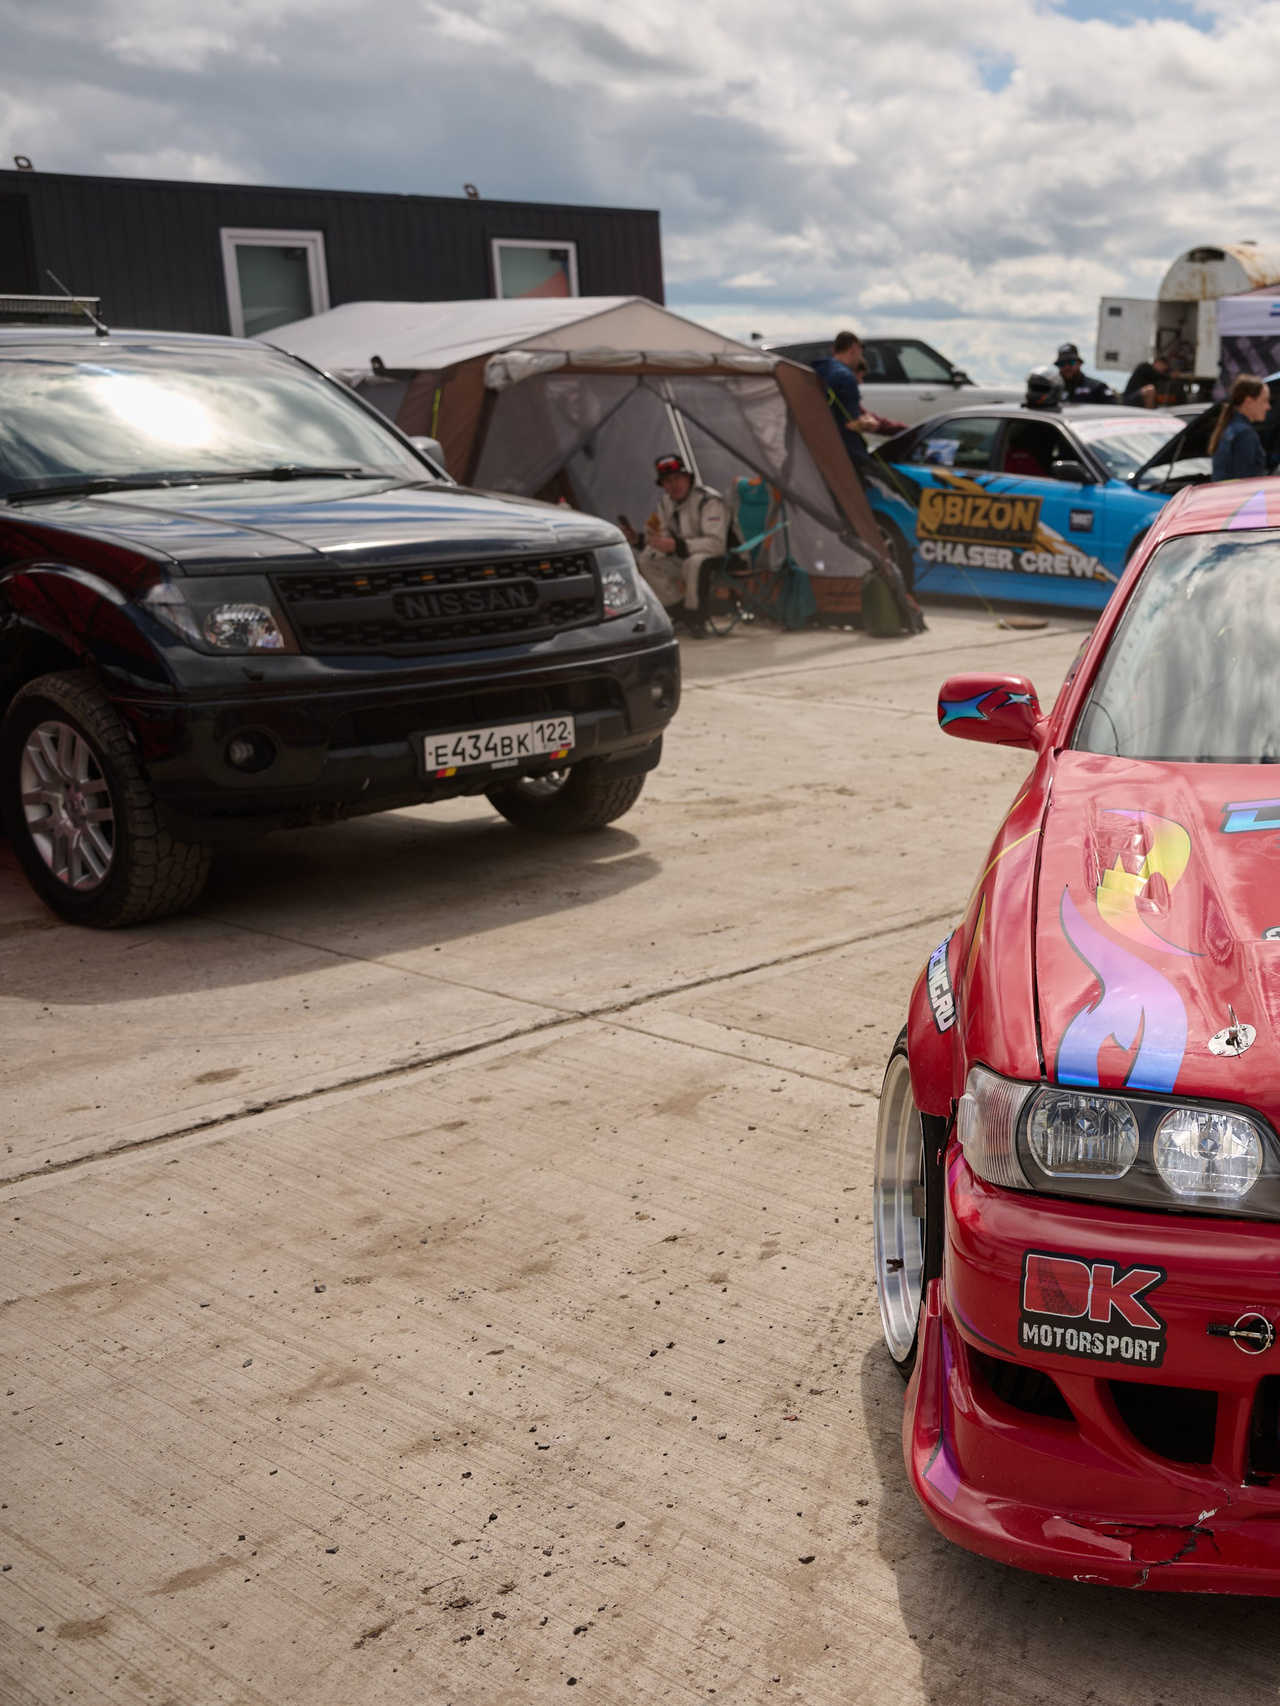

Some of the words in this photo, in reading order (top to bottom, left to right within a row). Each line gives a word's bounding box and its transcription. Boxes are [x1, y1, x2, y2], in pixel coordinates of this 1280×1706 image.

[943, 495, 1037, 532] BIZON
[919, 541, 1015, 571] CHASER
[1019, 550, 1098, 579] CREW
[403, 584, 529, 619] NISSAN
[535, 721, 568, 743] 122
[1023, 1253, 1162, 1331] DK
[1023, 1322, 1160, 1362] MOTORSPORT
